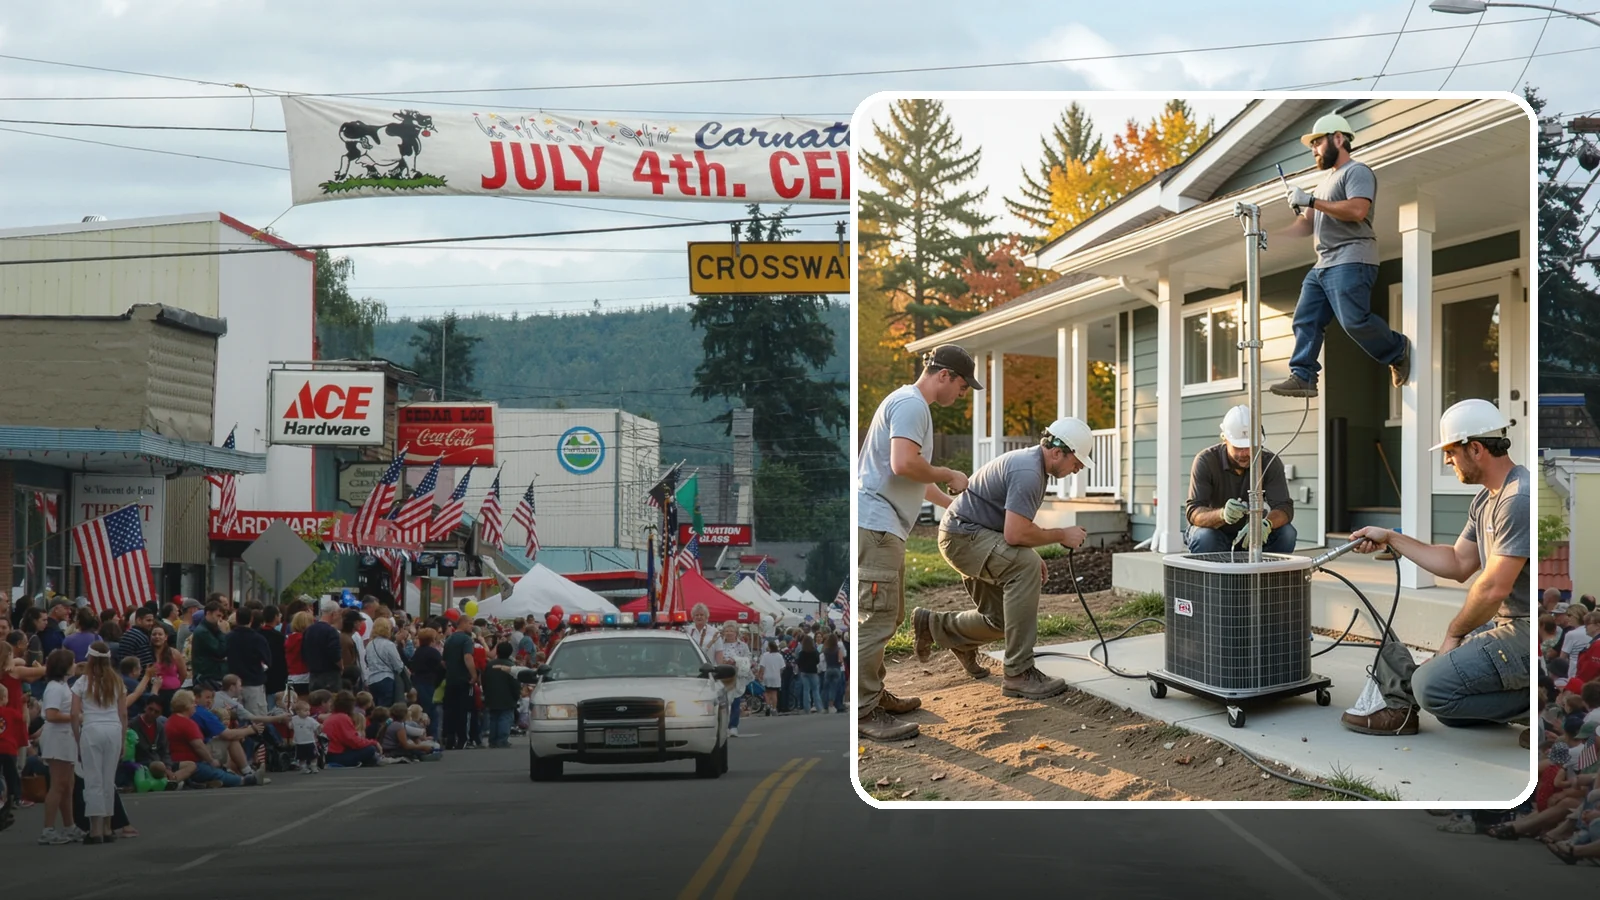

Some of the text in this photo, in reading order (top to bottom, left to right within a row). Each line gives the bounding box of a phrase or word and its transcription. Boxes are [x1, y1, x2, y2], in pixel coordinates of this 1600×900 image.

[694, 121, 850, 150] Carnat
[481, 141, 605, 193] JULY
[632, 150, 746, 198] 4th.
[697, 254, 850, 280] CROSSWA
[283, 380, 374, 420] ACE
[405, 409, 485, 422] CEDAR LOG
[283, 421, 371, 436] Hardware
[416, 428, 477, 447] Coca-Cola
[95, 484, 124, 495] Vincent
[126, 485, 136, 494] de
[137, 486, 155, 495] Paul
[688, 526, 742, 535] CRNATION
